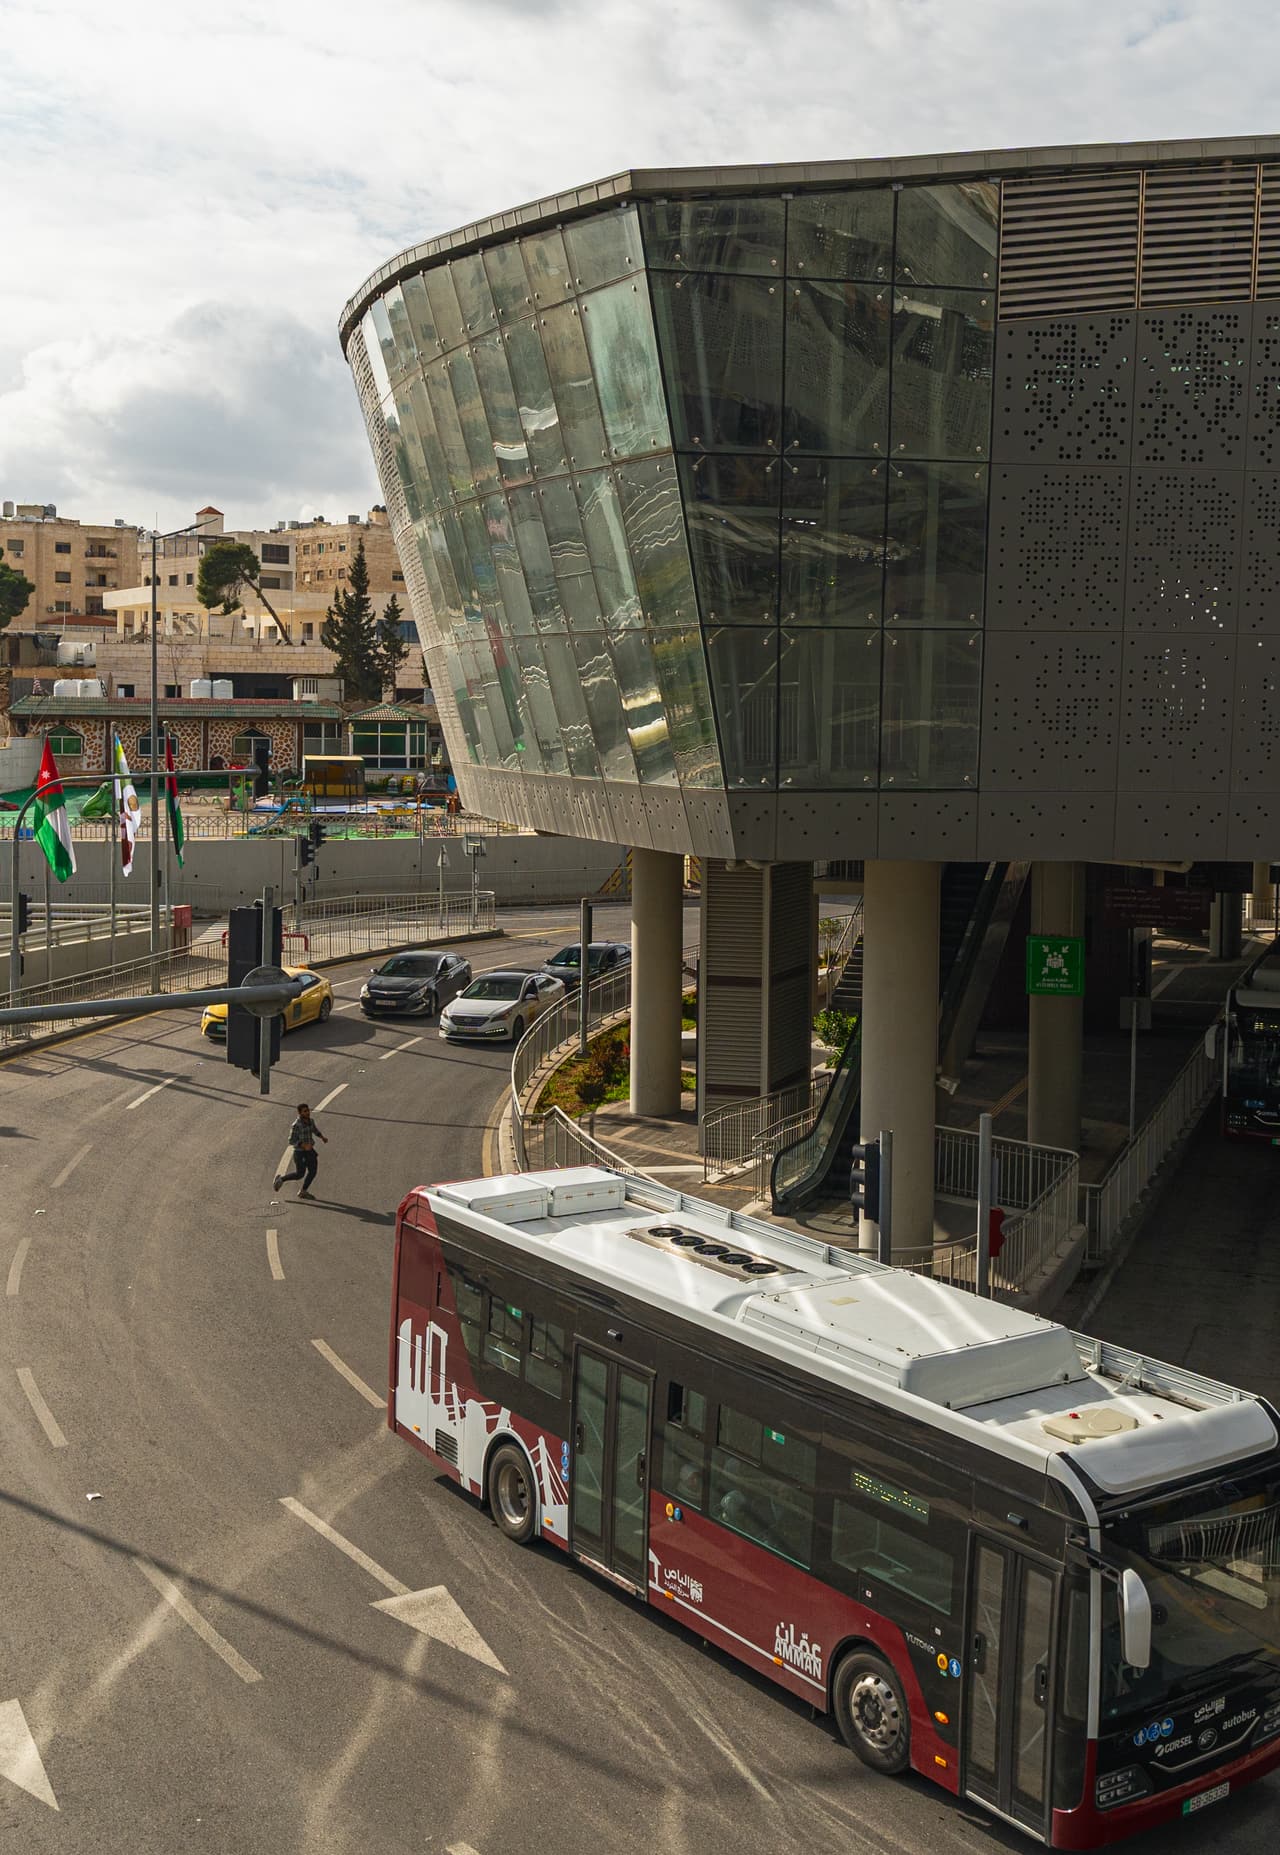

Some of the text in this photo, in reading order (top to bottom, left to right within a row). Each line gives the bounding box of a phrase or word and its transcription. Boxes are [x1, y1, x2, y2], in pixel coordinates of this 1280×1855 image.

[664, 1568, 690, 1589] الباص
[774, 1637, 822, 1680] AMMAN
[1222, 1707, 1257, 1730] autobus
